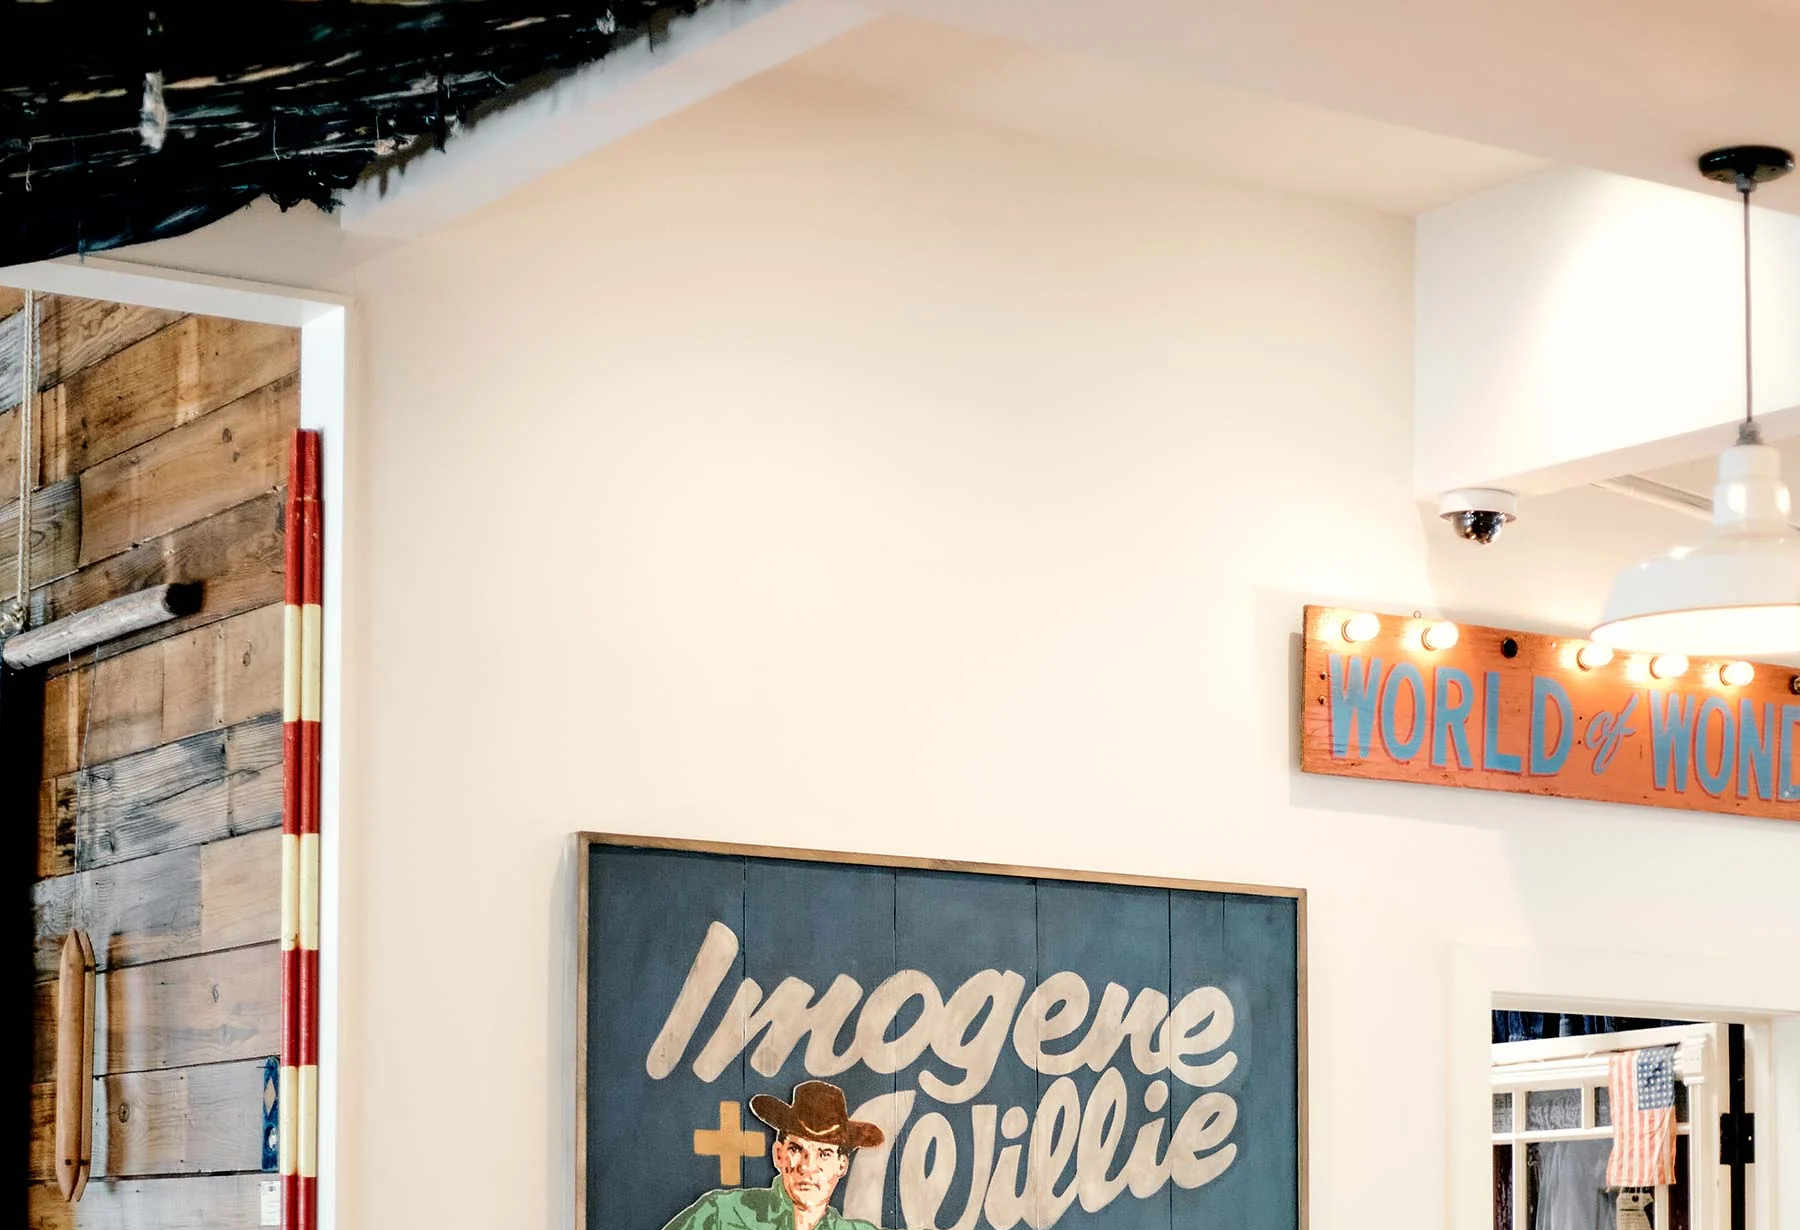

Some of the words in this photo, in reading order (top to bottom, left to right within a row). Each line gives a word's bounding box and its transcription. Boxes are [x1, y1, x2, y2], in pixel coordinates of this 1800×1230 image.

[1327, 653, 1574, 777] WORLD
[1584, 692, 1638, 776] of
[645, 920, 1238, 1104] Imogene
